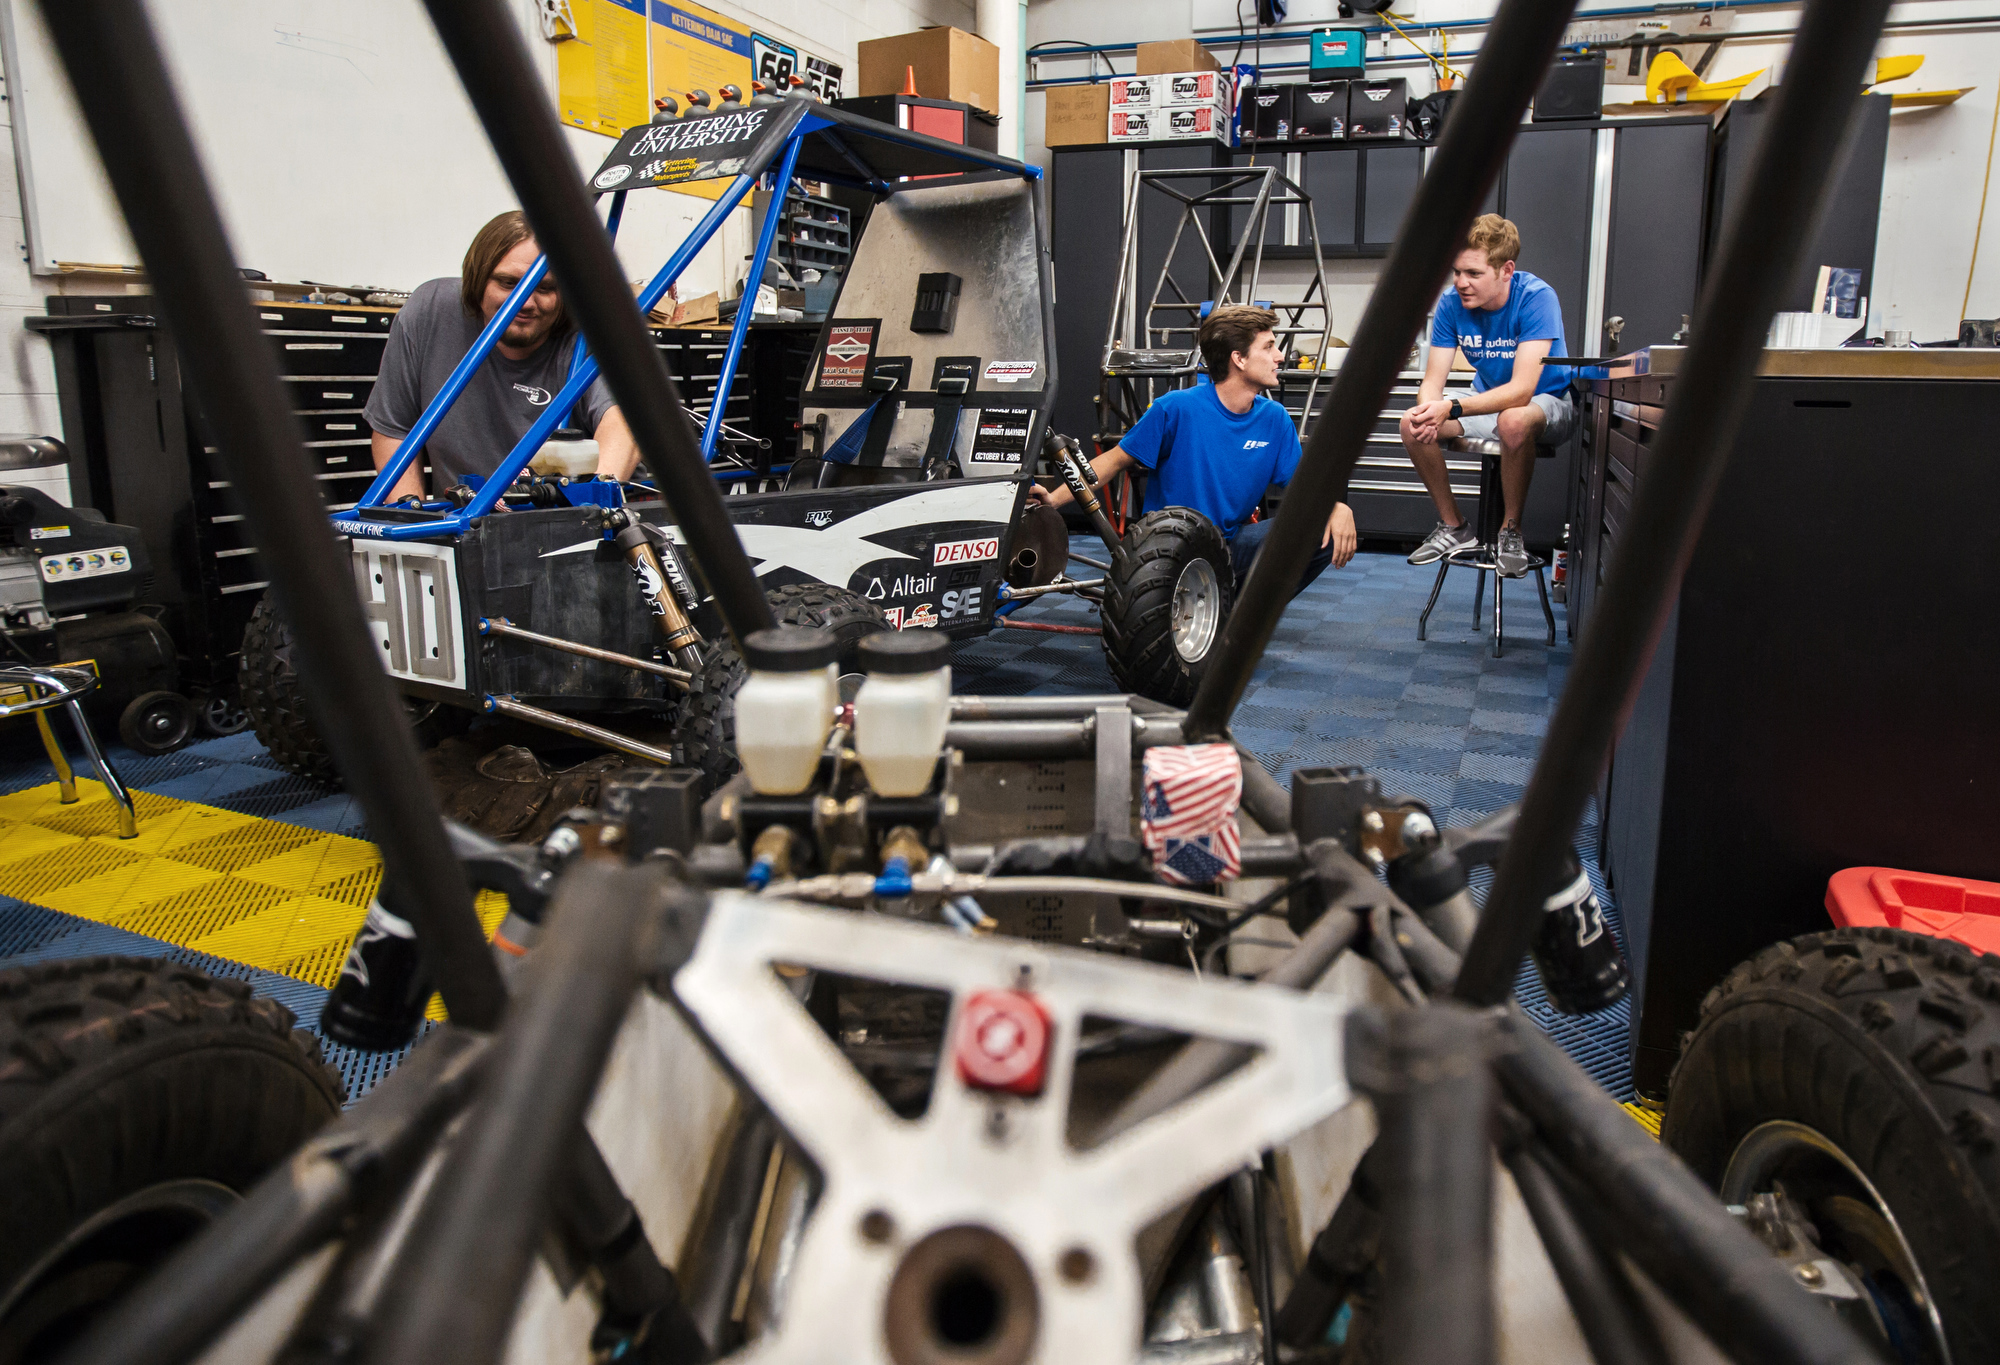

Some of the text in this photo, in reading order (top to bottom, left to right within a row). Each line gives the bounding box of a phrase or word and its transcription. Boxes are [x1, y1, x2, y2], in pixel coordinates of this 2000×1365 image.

[671, 12, 734, 48] KETTERING BAJA SAE
[640, 108, 768, 142] KETTERING
[629, 123, 762, 157] UNIVERSITY
[1485, 350, 1500, 359] for
[974, 451, 1000, 461] OCTOBER
[804, 510, 833, 527] FOX
[367, 524, 386, 537] FINE
[935, 540, 998, 563] DENSO
[890, 572, 938, 598] Altair
[940, 586, 982, 619] SAE
[939, 615, 980, 627] INTERNATIONAL
